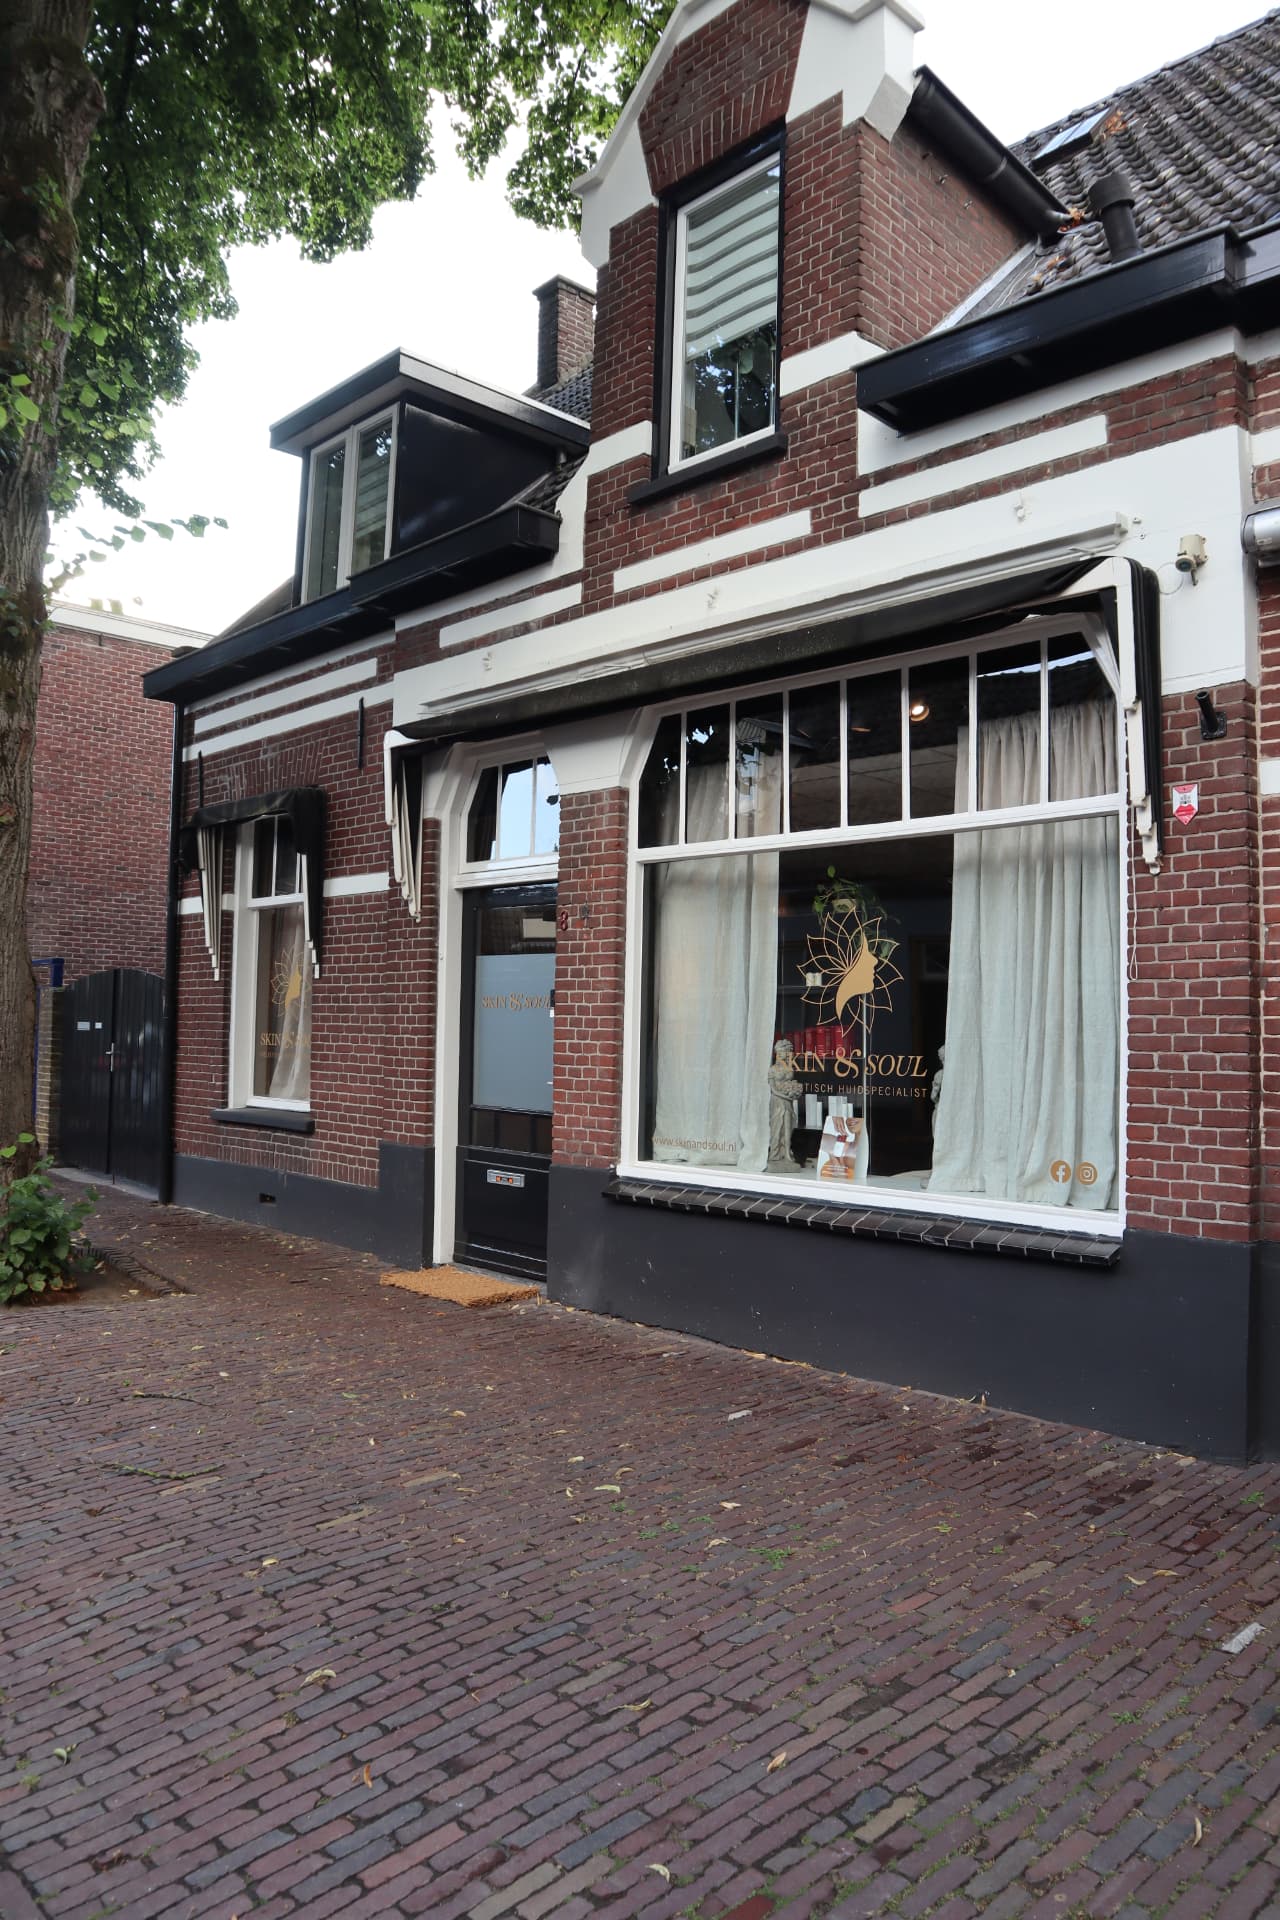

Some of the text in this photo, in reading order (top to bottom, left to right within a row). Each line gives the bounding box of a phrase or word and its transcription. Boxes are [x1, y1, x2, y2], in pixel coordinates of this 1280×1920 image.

[560, 910, 569, 931] 8
[481, 995, 506, 1008] SKIN
[509, 992, 524, 1011] &
[260, 1032, 281, 1047] SKIN
[834, 1046, 862, 1079] &
[865, 1054, 928, 1078] SOUL
[838, 1083, 928, 1099] HUIDSPECIALIST
